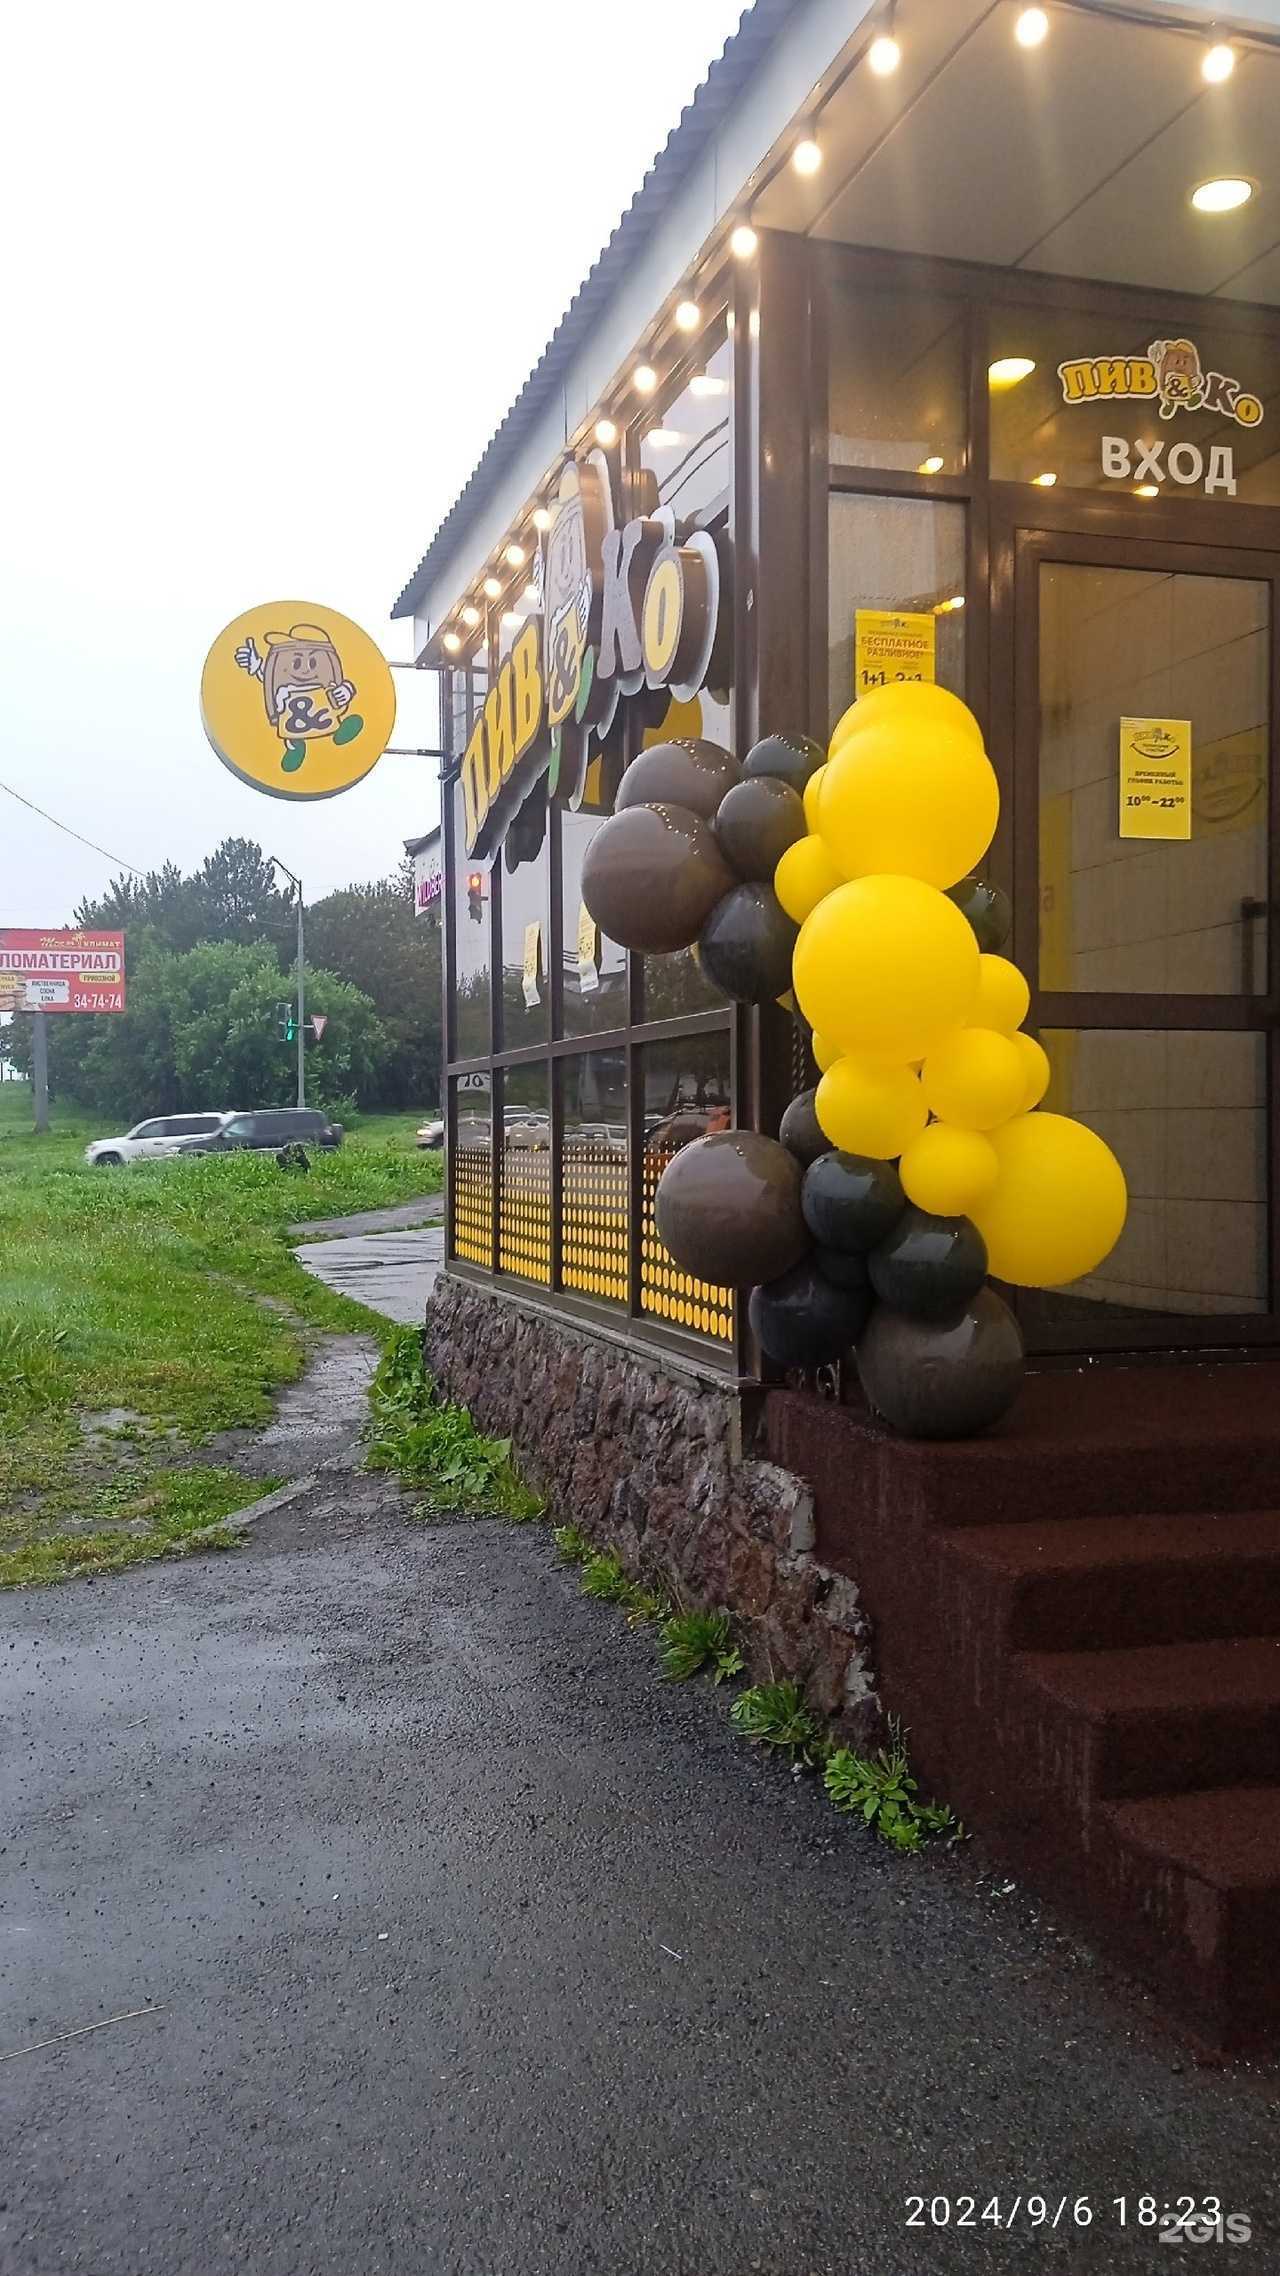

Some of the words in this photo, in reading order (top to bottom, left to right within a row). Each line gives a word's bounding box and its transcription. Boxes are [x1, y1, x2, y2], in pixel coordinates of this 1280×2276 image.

[1062, 358, 1158, 400] ПИВ
[1102, 436, 1237, 496] ВХОД
[861, 636, 929, 650] БЕСПЛАТНОЕ
[462, 614, 543, 859] ПИВ
[74, 993, 122, 1009] 34-74-74
